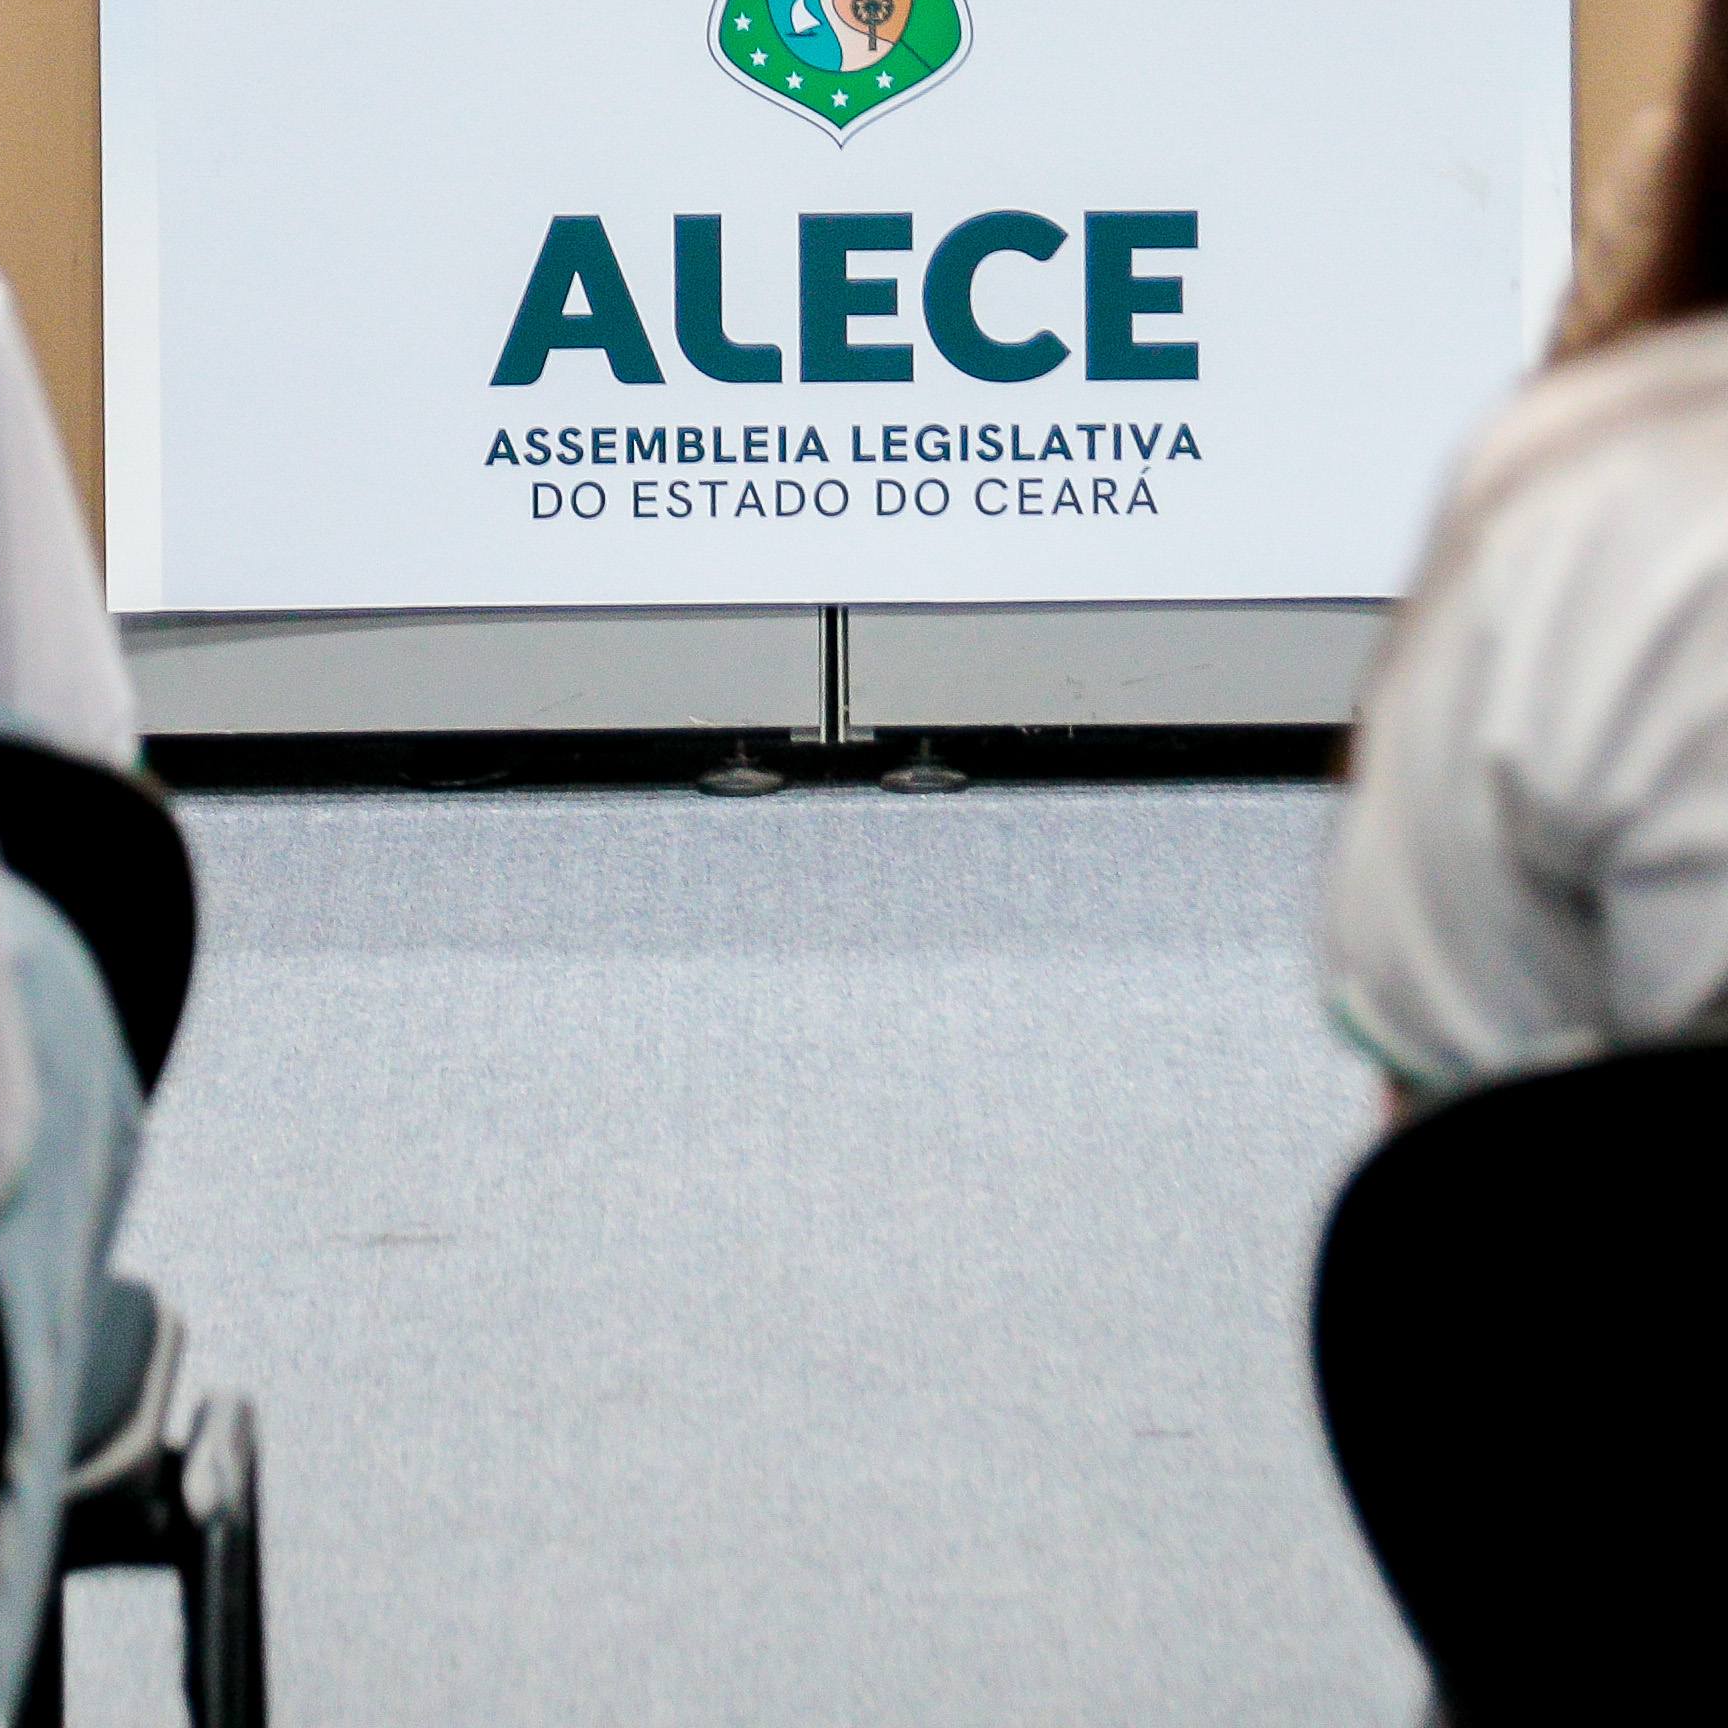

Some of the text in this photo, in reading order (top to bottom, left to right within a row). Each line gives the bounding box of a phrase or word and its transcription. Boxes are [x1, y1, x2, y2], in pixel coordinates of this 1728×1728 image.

[489, 209, 1200, 387] ALECE
[484, 423, 1202, 467] ASSEMBLEIA LEGISLATIVA
[532, 465, 1160, 520] DO ESTADO DO CEARÁ
